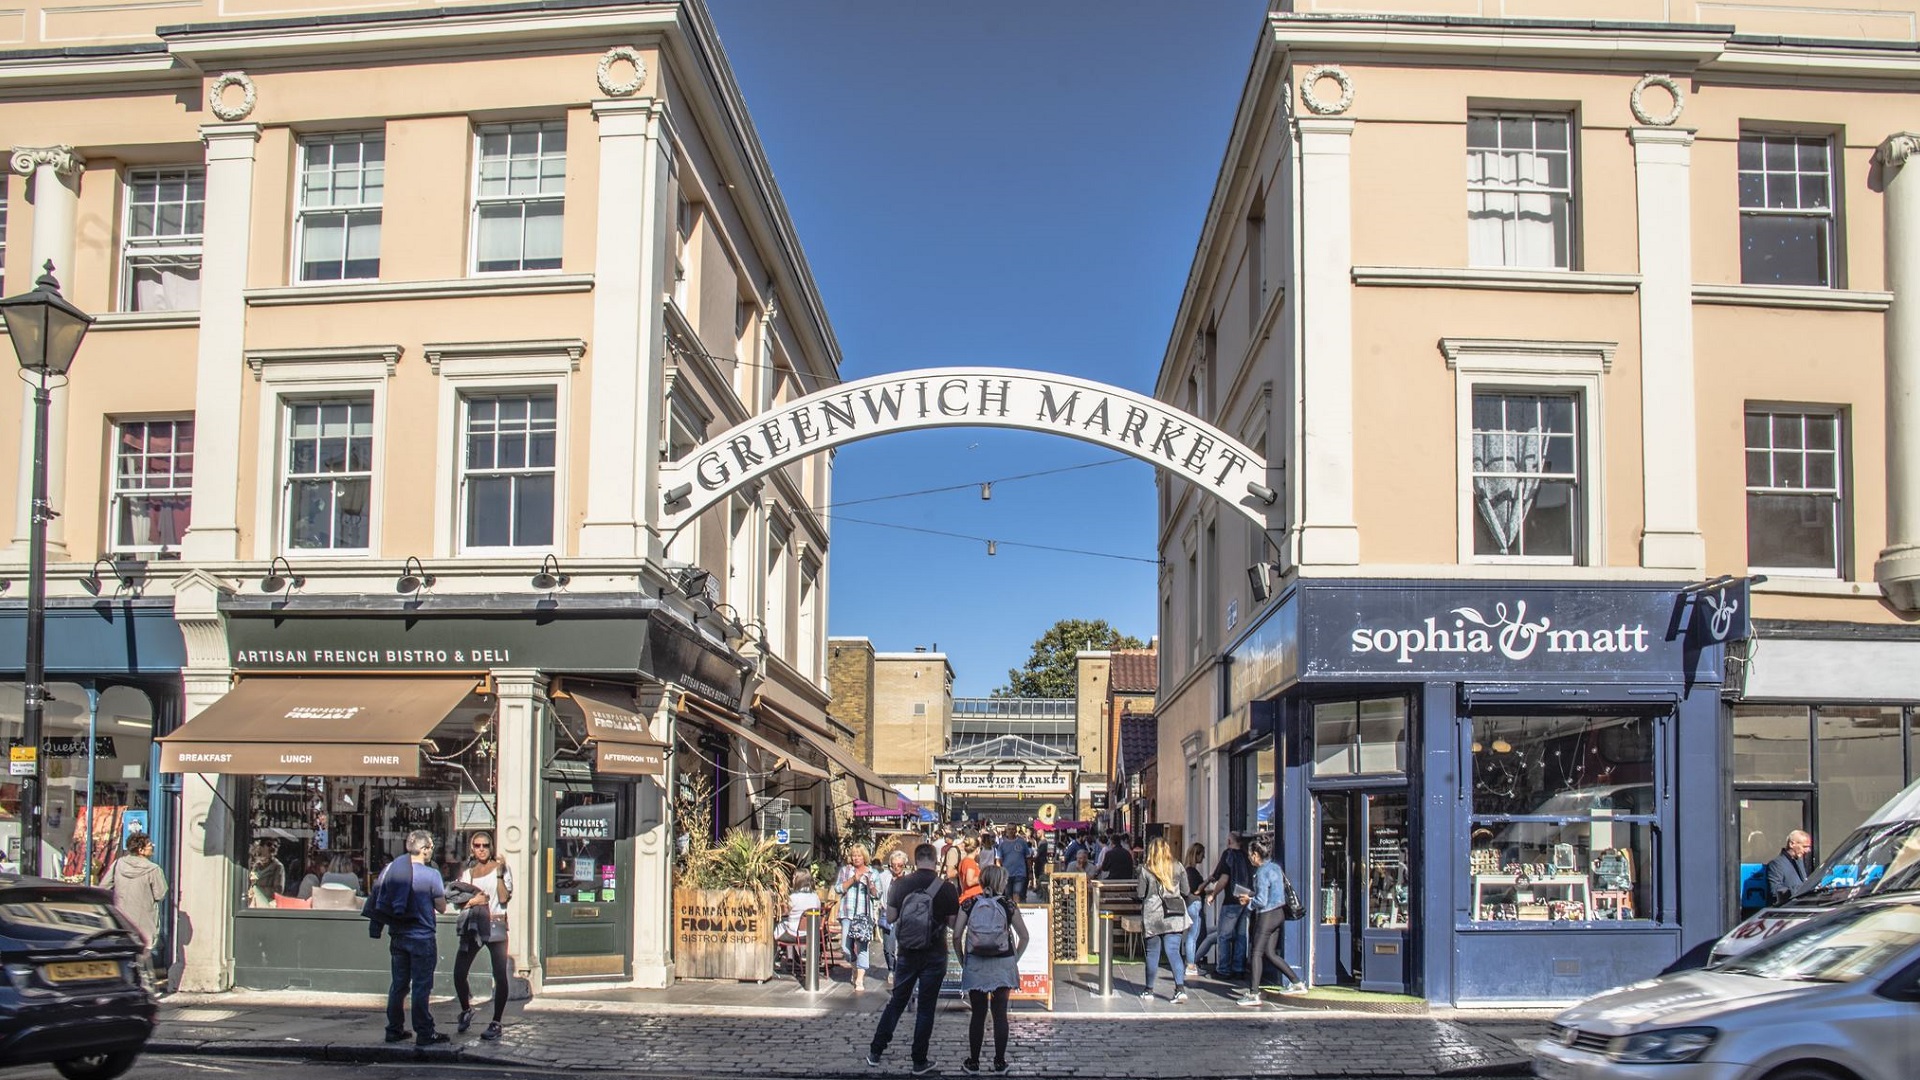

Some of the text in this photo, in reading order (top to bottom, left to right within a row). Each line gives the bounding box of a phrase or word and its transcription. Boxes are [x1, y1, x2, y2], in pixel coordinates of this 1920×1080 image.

[695, 378, 1248, 491] GREENWICH MARKET
[1351, 616, 1493, 663] sophia
[1547, 623, 1649, 653] matt
[237, 649, 509, 663] ARTISAN FRENCH BISTRO & DELI
[680, 673, 700, 690] ARTISAN
[699, 682, 715, 698] FRENCH
[284, 711, 355, 720] FROMAGE
[594, 717, 643, 732] FROMAGE
[42, 741, 103, 753] QuestAt
[178, 753, 400, 765] BREAKFAST LUNCH DINNER
[604, 753, 659, 764] AFTERNOON TEA
[947, 776, 1066, 785] GREENWICH MARKET
[560, 828, 608, 837] FROMAGE
[681, 917, 757, 932] FROMAGE
[681, 934, 718, 943] BISTRO
[730, 935, 758, 943] SHOP
